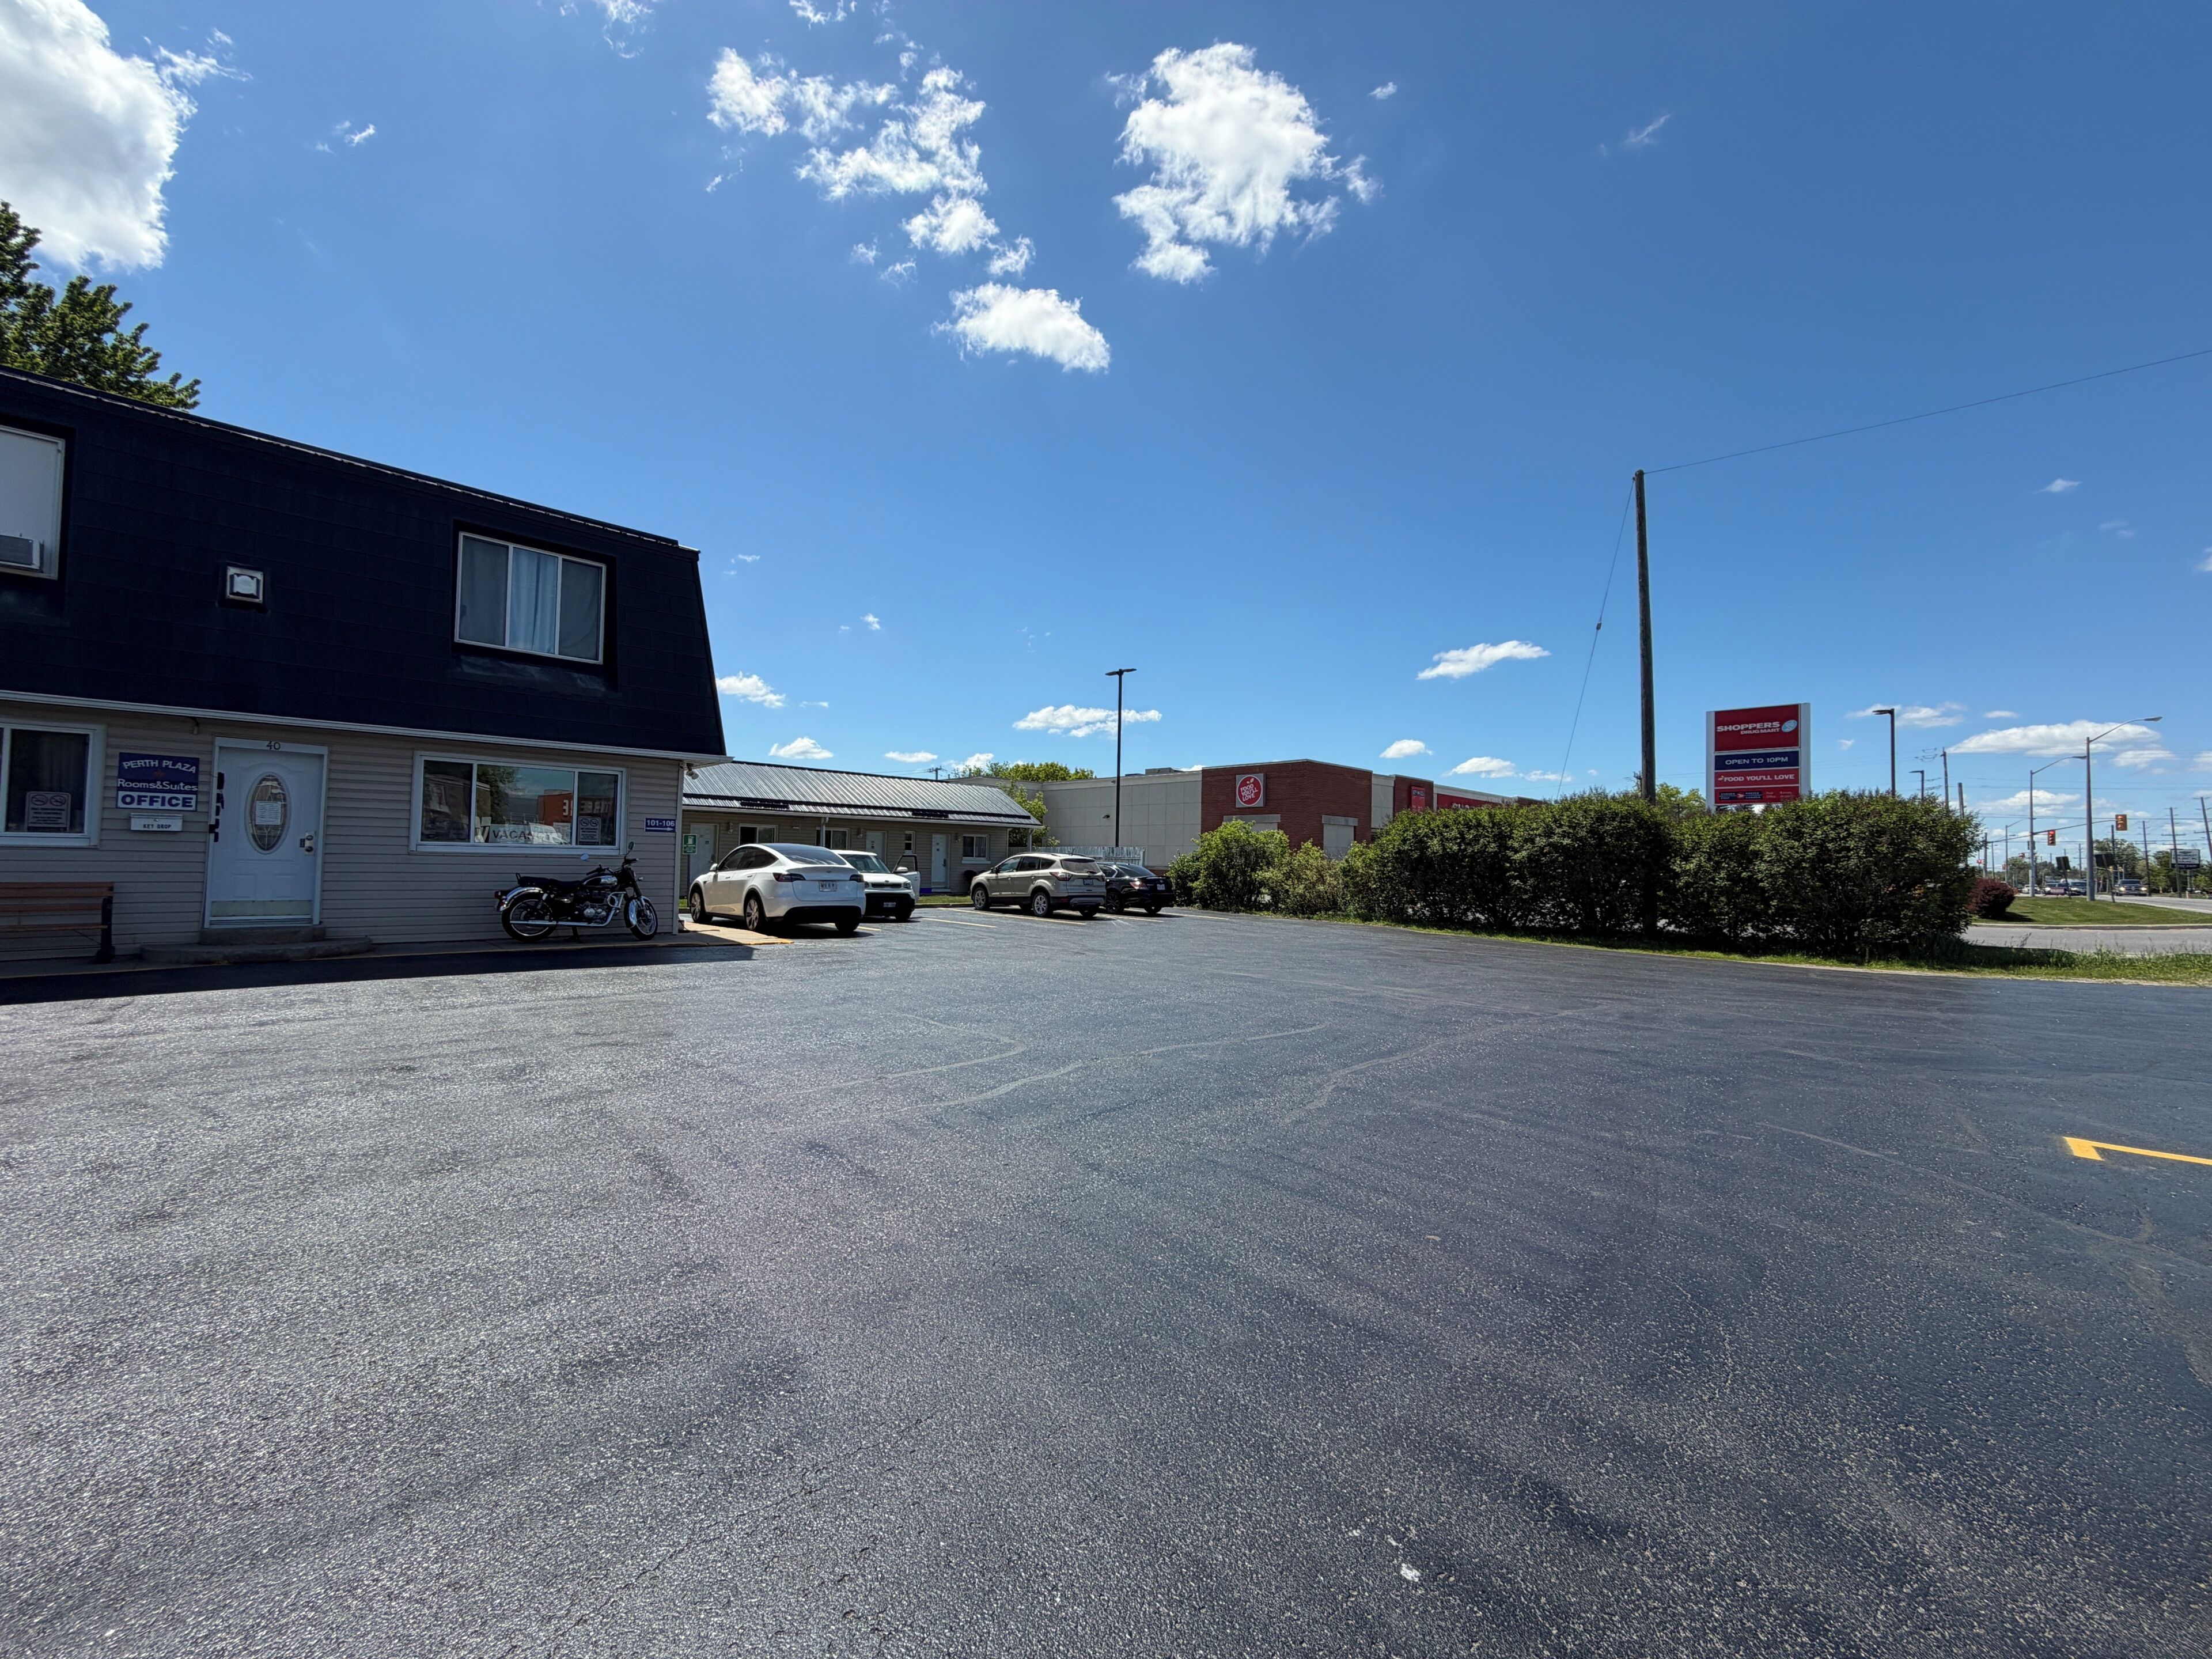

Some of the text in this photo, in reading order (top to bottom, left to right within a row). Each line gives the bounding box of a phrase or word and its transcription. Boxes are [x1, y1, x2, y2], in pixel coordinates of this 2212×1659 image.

[1717, 722, 1781, 732] SHOPPERS
[267, 741, 281, 750] 40
[123, 760, 196, 774] PERTH PLAZA
[118, 778, 198, 791] Rooms&Suites
[1240, 784, 1254, 793] FOOD
[121, 794, 194, 808] OFFICE
[1243, 793, 1256, 801] LOVE
